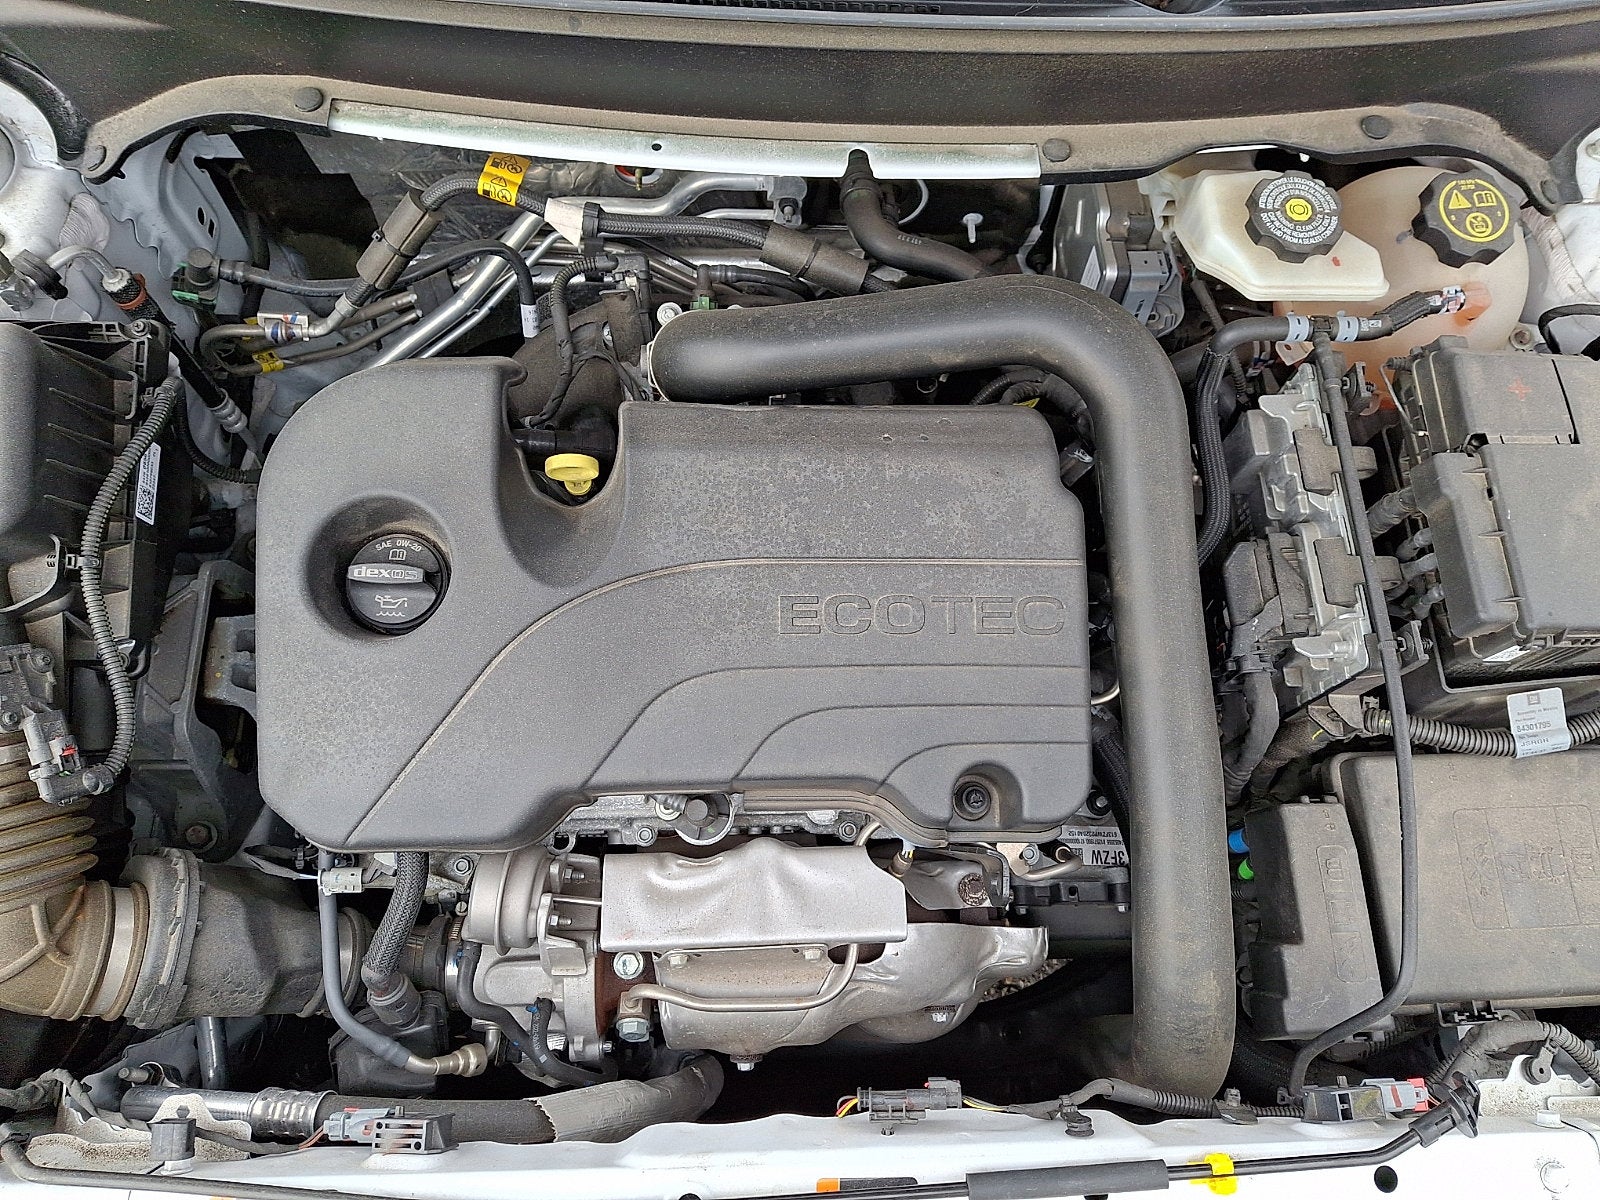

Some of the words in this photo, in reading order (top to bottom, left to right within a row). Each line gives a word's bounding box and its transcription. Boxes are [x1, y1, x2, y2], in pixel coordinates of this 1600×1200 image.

[1261, 213, 1270, 223] DOT
[1269, 224, 1283, 236] FLUID
[1282, 234, 1298, 243] FROM
[1303, 235, 1322, 244] SEALED
[1321, 216, 1338, 238] CONTAINER
[1274, 220, 1292, 235] BEFORE
[375, 540, 392, 551] SAE
[396, 540, 422, 552] 0W-20
[778, 594, 1065, 635] ECOTEC
[1091, 849, 1126, 865] 3FZW
